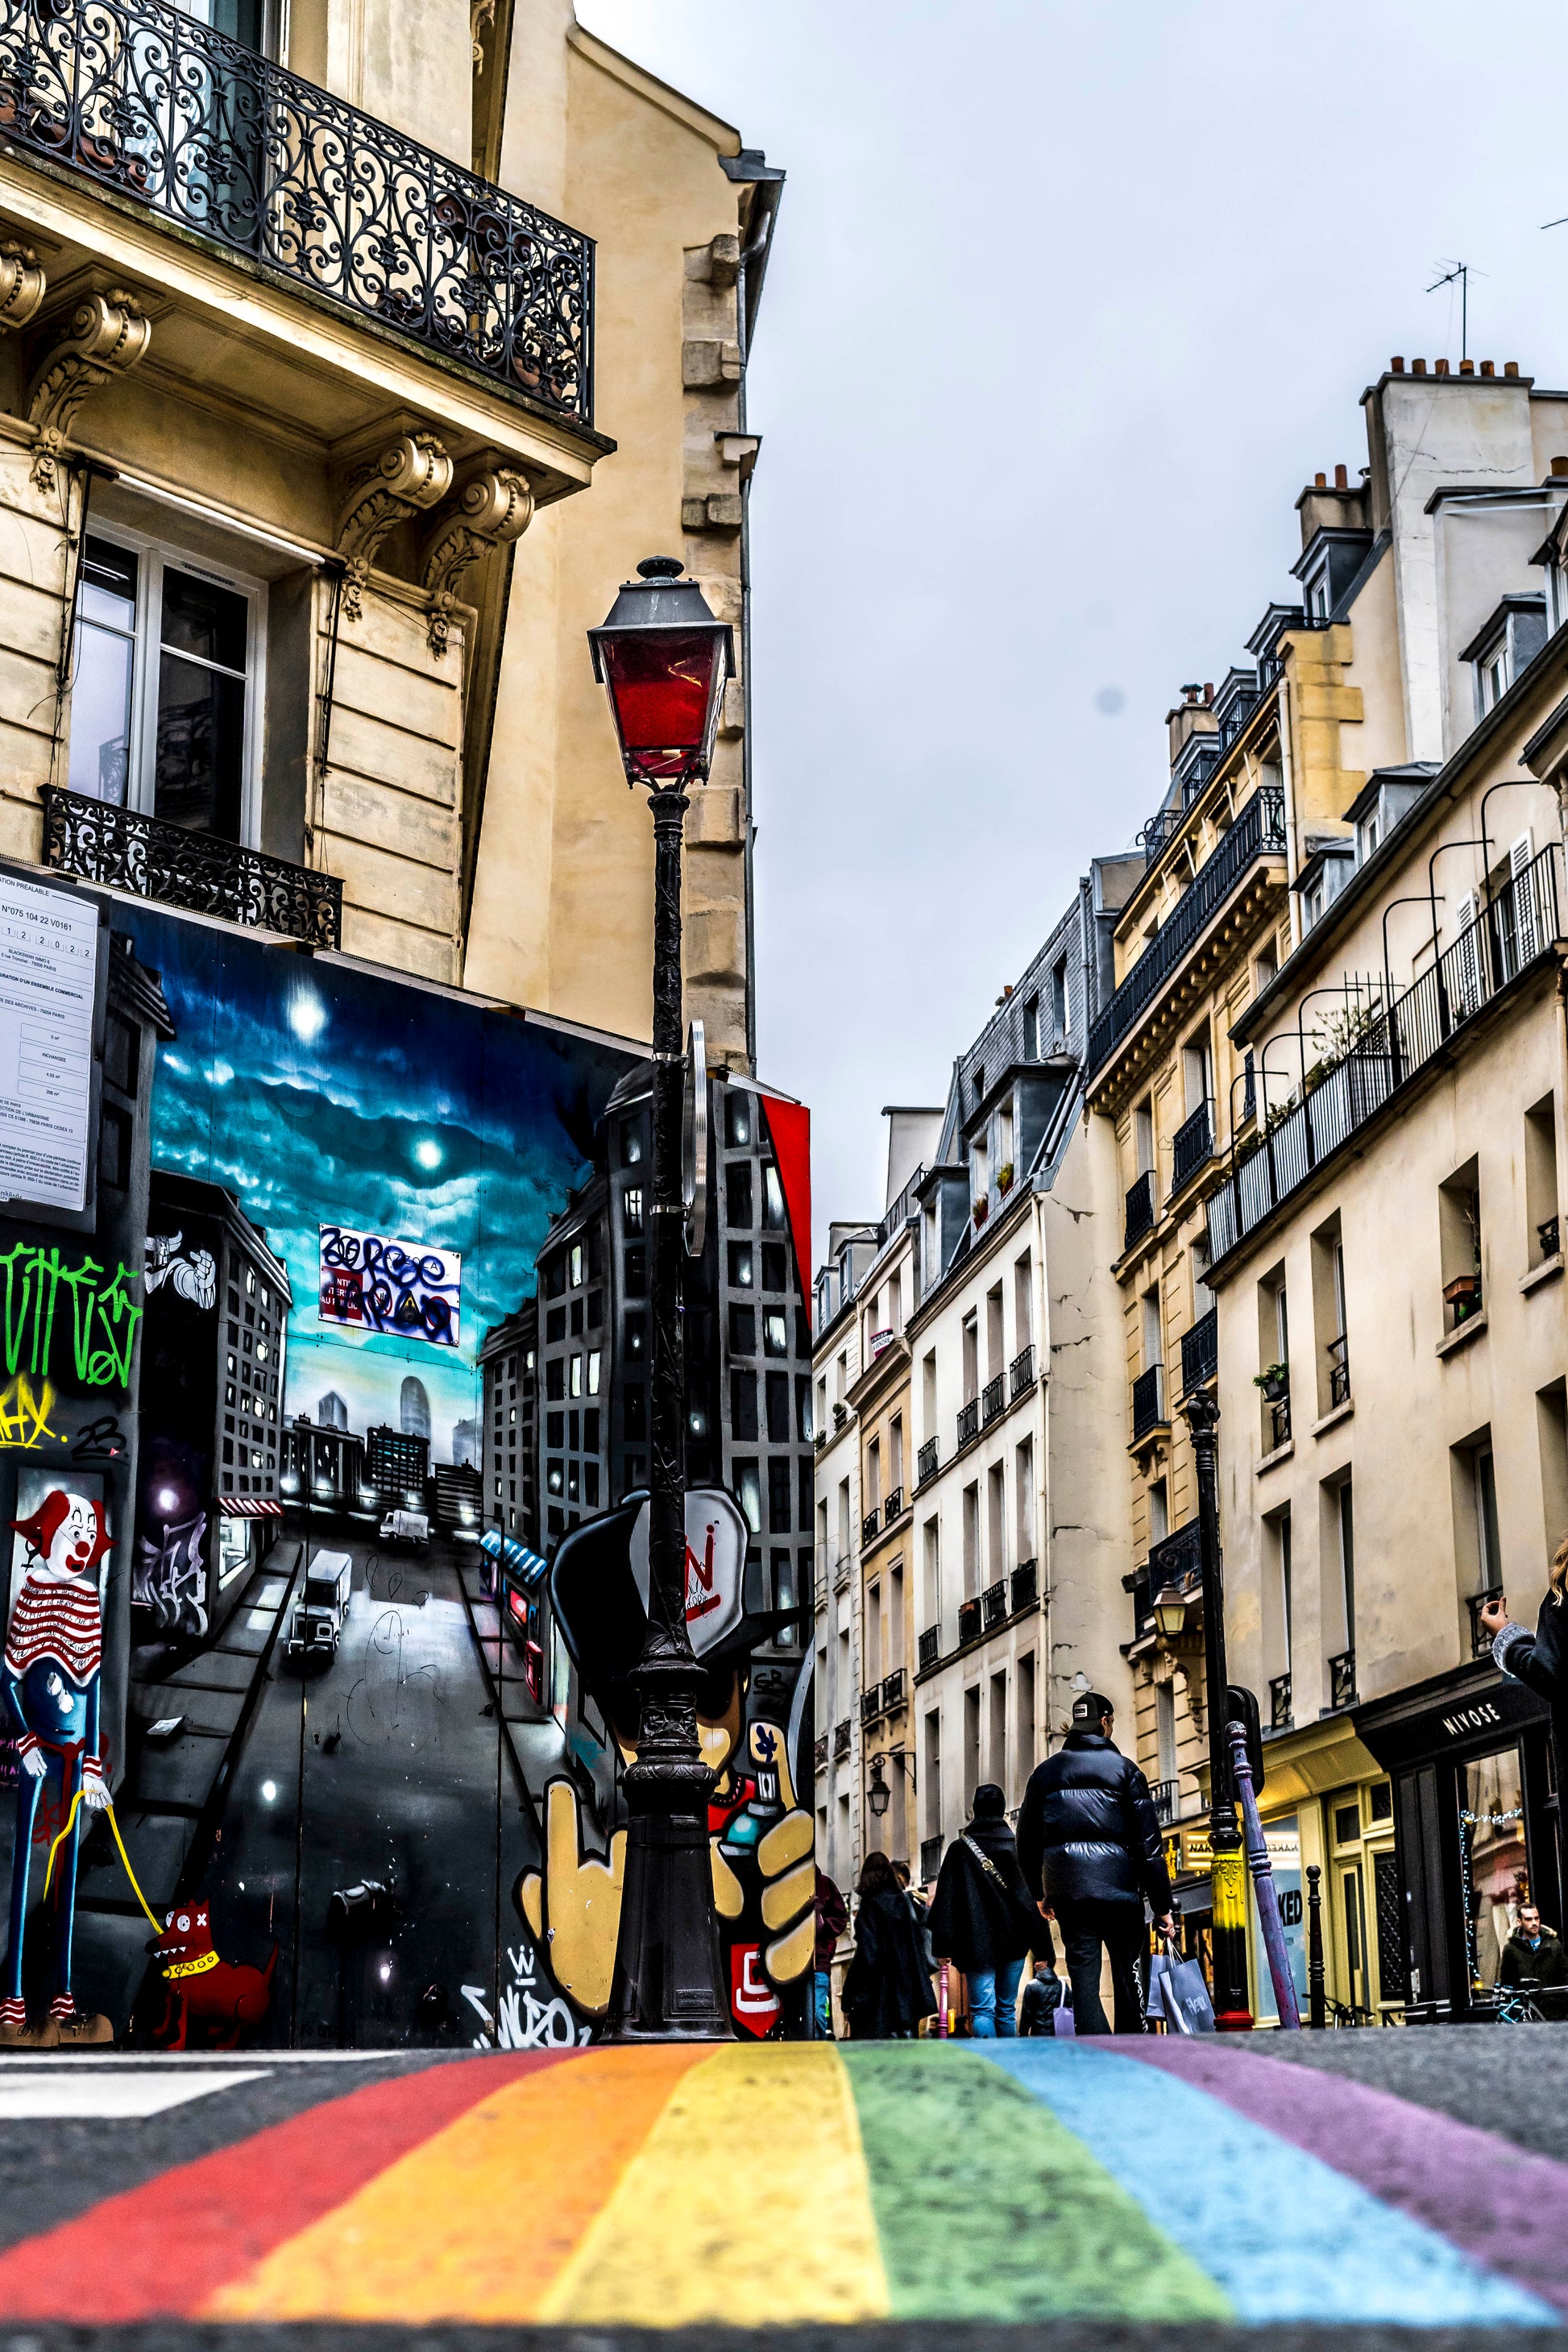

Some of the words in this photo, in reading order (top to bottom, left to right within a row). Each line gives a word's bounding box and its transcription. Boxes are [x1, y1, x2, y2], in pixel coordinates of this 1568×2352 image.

[17, 882, 49, 896] PRÉALABLE
[26, 912, 38, 921] 104
[39, 916, 48, 925] 22
[50, 919, 72, 931] V0161
[9, 949, 34, 960] BLACKSWAN
[31, 981, 54, 991] ENSEMBLE
[55, 987, 83, 999] COMMERCIAL
[15, 1002, 36, 1011] ARCHIVES
[22, 1111, 49, 1121] L'URBANISME
[375, 1249, 438, 1271] AZZOA
[1442, 1703, 1500, 1736] NIVOSE
[1278, 1889, 1303, 1927] KED
